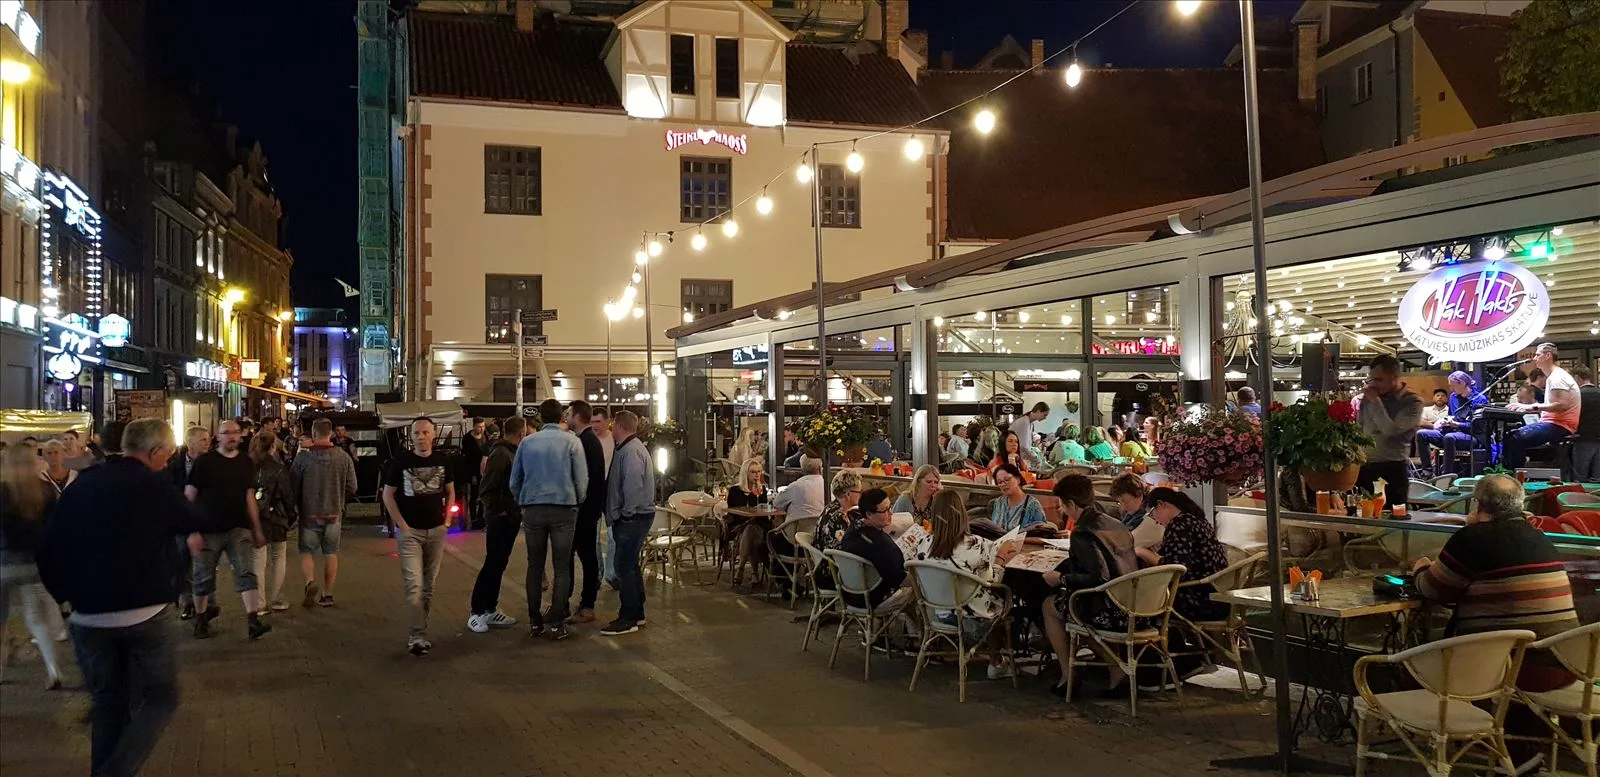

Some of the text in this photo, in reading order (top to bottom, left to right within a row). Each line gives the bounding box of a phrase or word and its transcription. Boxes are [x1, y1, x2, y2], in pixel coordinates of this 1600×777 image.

[1409, 291, 1539, 352] LATVIEŠU MŪZIKAS SKATUVE
